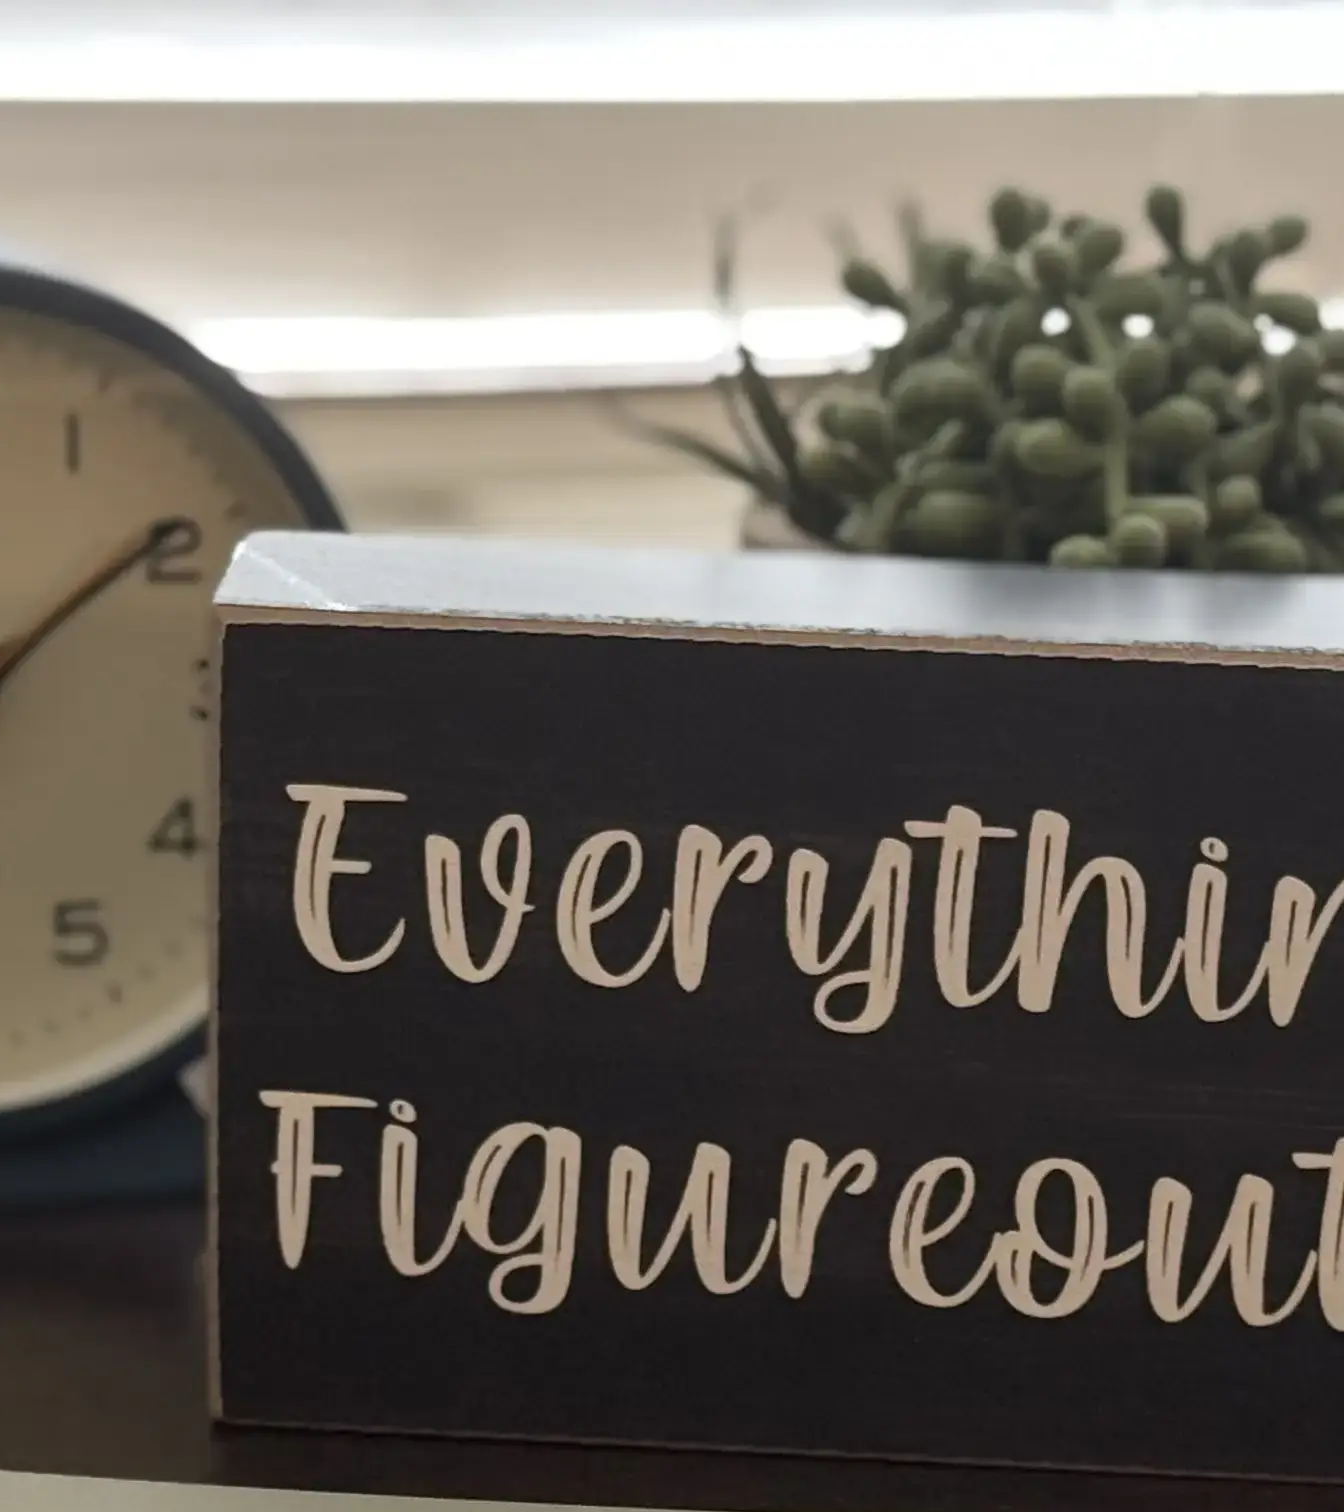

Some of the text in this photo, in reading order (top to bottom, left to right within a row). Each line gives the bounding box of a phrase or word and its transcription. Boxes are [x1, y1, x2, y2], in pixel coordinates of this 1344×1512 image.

[65, 413, 81, 474] 1
[147, 515, 203, 585] 2
[145, 797, 208, 861] 4
[54, 901, 109, 965] 5
